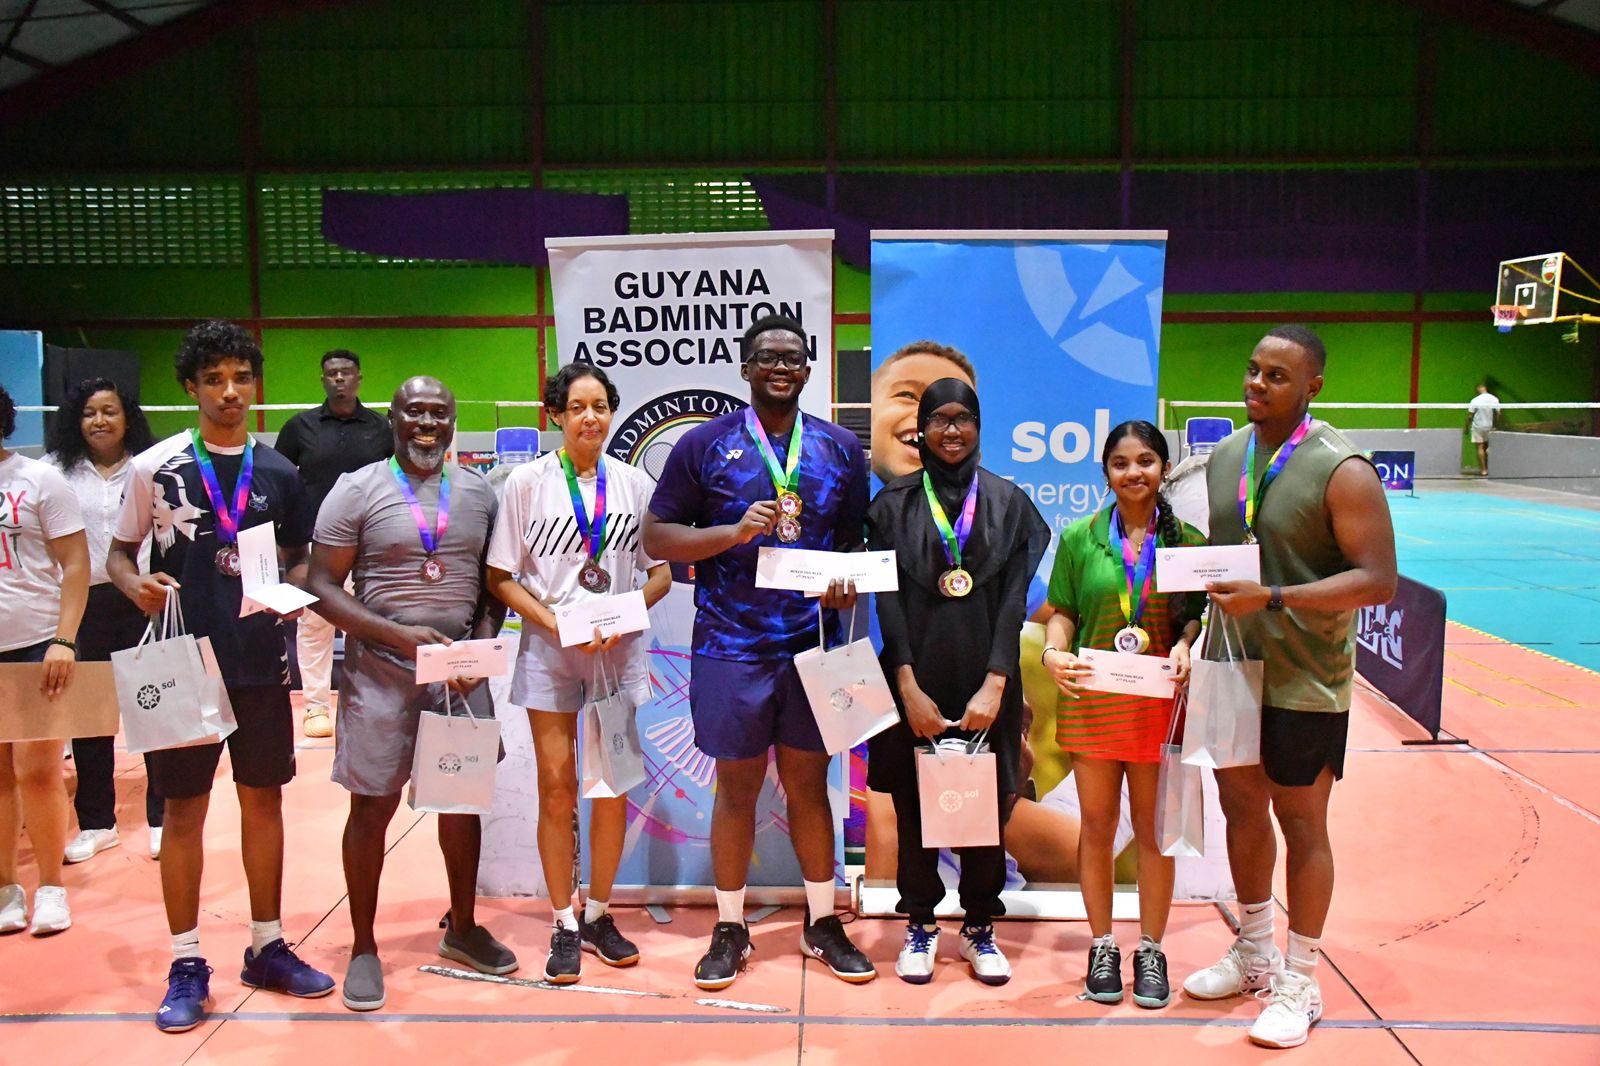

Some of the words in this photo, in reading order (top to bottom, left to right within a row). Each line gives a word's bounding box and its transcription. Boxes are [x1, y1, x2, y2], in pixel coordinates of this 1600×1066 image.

[614, 269, 770, 299] GUYANA
[583, 302, 803, 334] BADMINTON
[572, 335, 817, 368] ASSOCIATN
[613, 395, 740, 463] ADMINTON
[1012, 409, 1110, 463] sol
[1000, 476, 1109, 513] nergy
[162, 678, 176, 690] sol
[964, 788, 979, 798] sol
